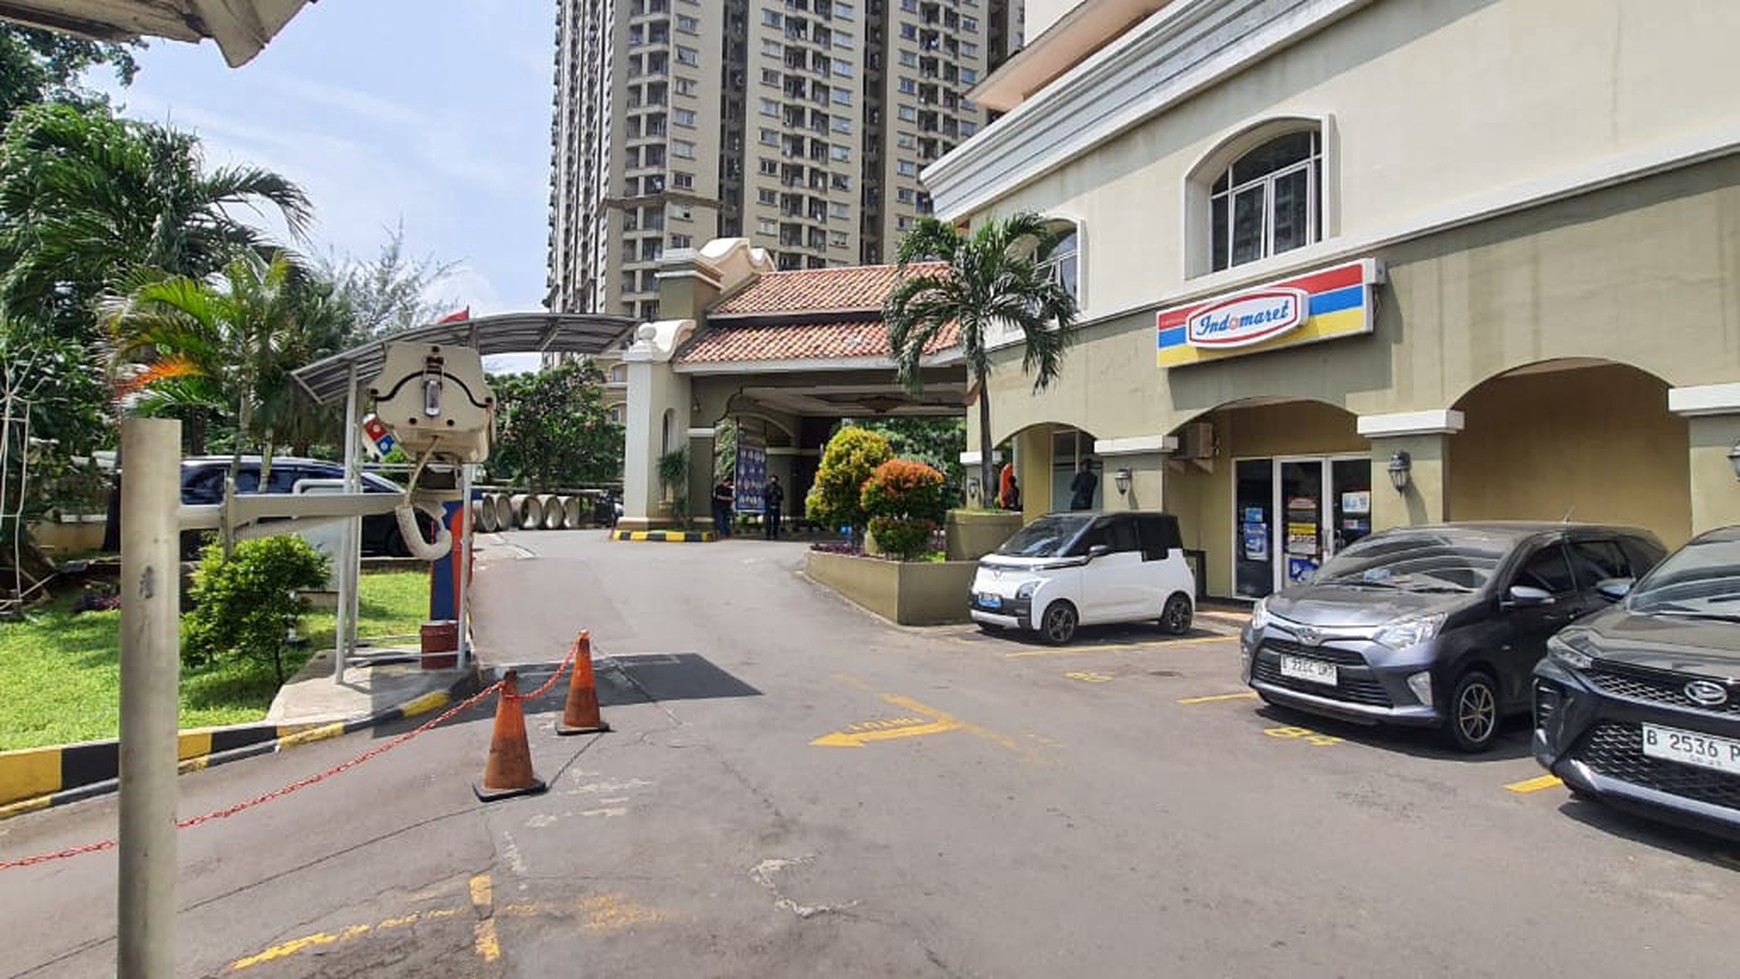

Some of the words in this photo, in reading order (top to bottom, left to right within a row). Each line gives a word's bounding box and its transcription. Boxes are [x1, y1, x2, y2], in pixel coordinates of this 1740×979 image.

[1196, 299, 1290, 336] Indomaret
[1646, 729, 1658, 746] B
[1669, 733, 1719, 758] 2536
